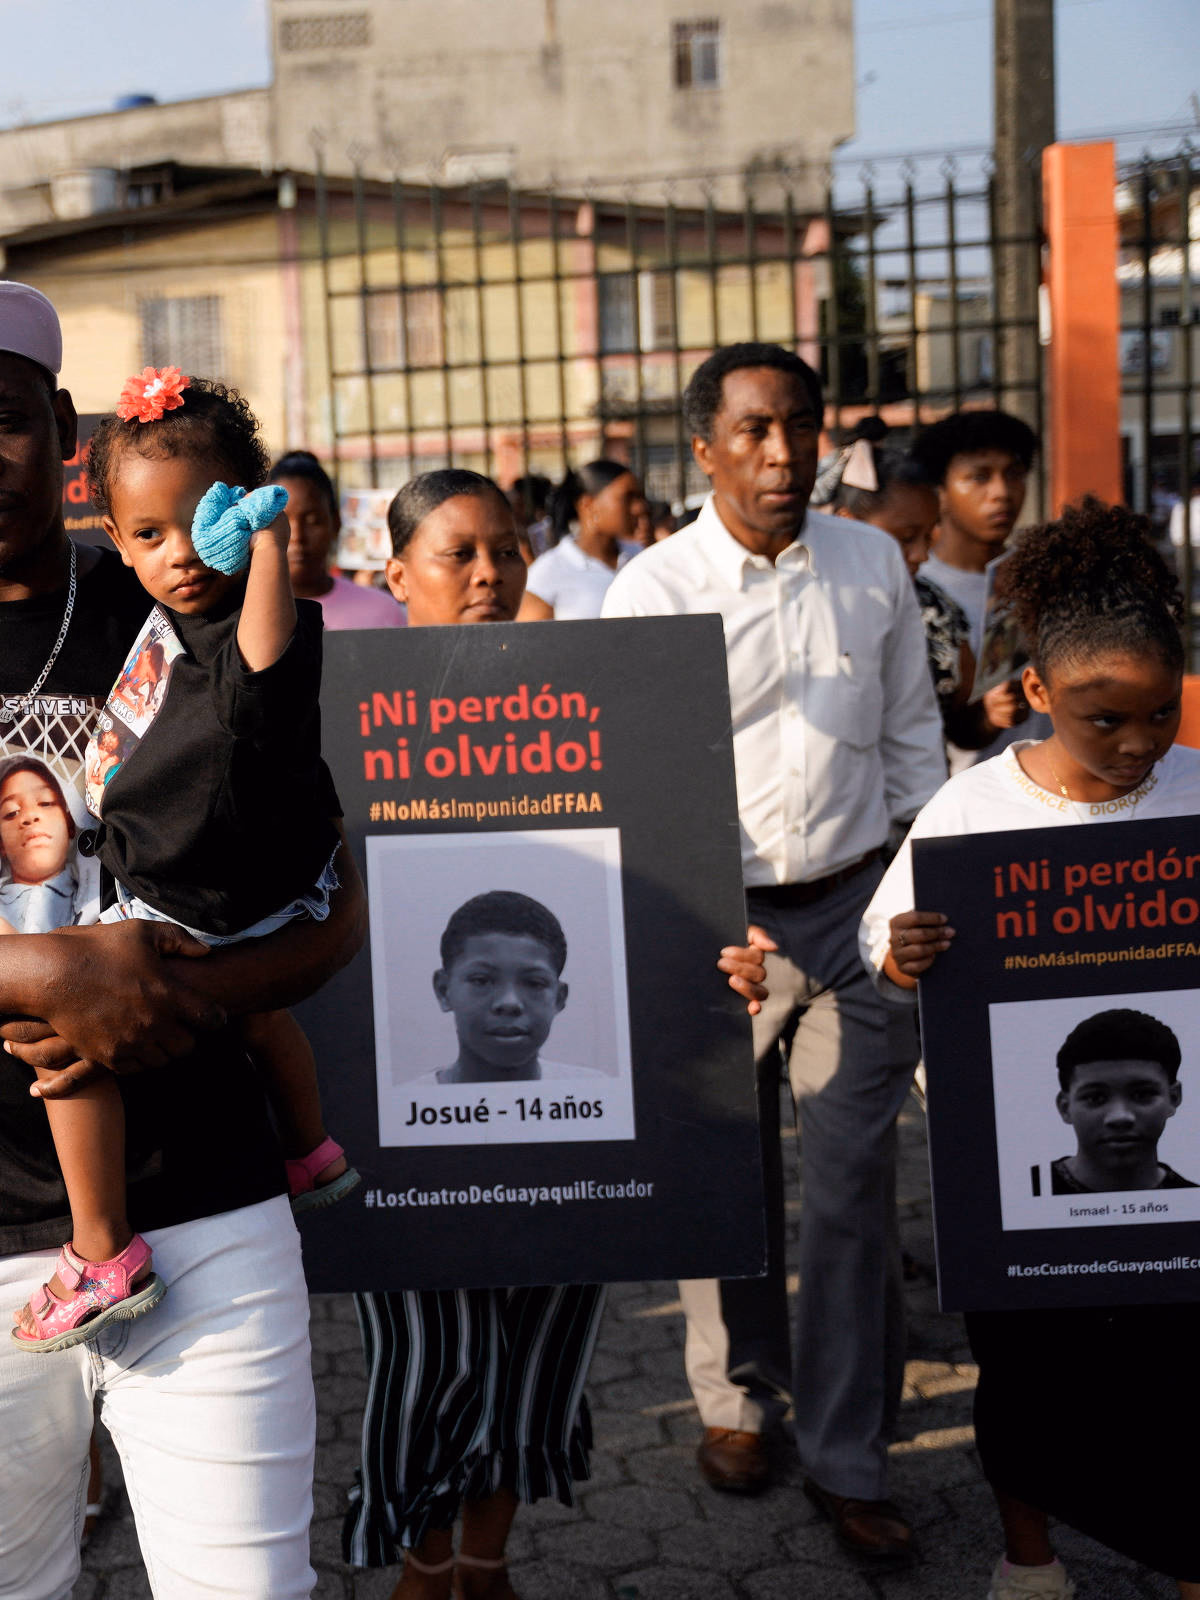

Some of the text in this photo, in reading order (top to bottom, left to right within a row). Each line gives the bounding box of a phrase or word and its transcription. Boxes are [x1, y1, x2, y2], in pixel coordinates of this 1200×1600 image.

[4, 698, 88, 715] STIVEN
[359, 684, 600, 736] ¡Ni perdón,
[364, 730, 603, 780] ni olvido!
[369, 792, 603, 821] #NoMásImpunidadFFAA
[994, 860, 1050, 897] ¡Ni
[996, 889, 1199, 938] ni olvido
[1004, 942, 1200, 968] #NoMásImpunidadFFA
[405, 1098, 490, 1126] Josué
[515, 1098, 543, 1121] 14
[549, 1096, 603, 1120] años
[365, 1179, 654, 1207] #LosCuatroDeGuayaquilEcuador
[1069, 1205, 1110, 1217] Ismael
[1122, 1203, 1136, 1214] 15
[1139, 1202, 1169, 1213] años
[1007, 1256, 1200, 1277] #LosCuatrodeGuayaquilEc
